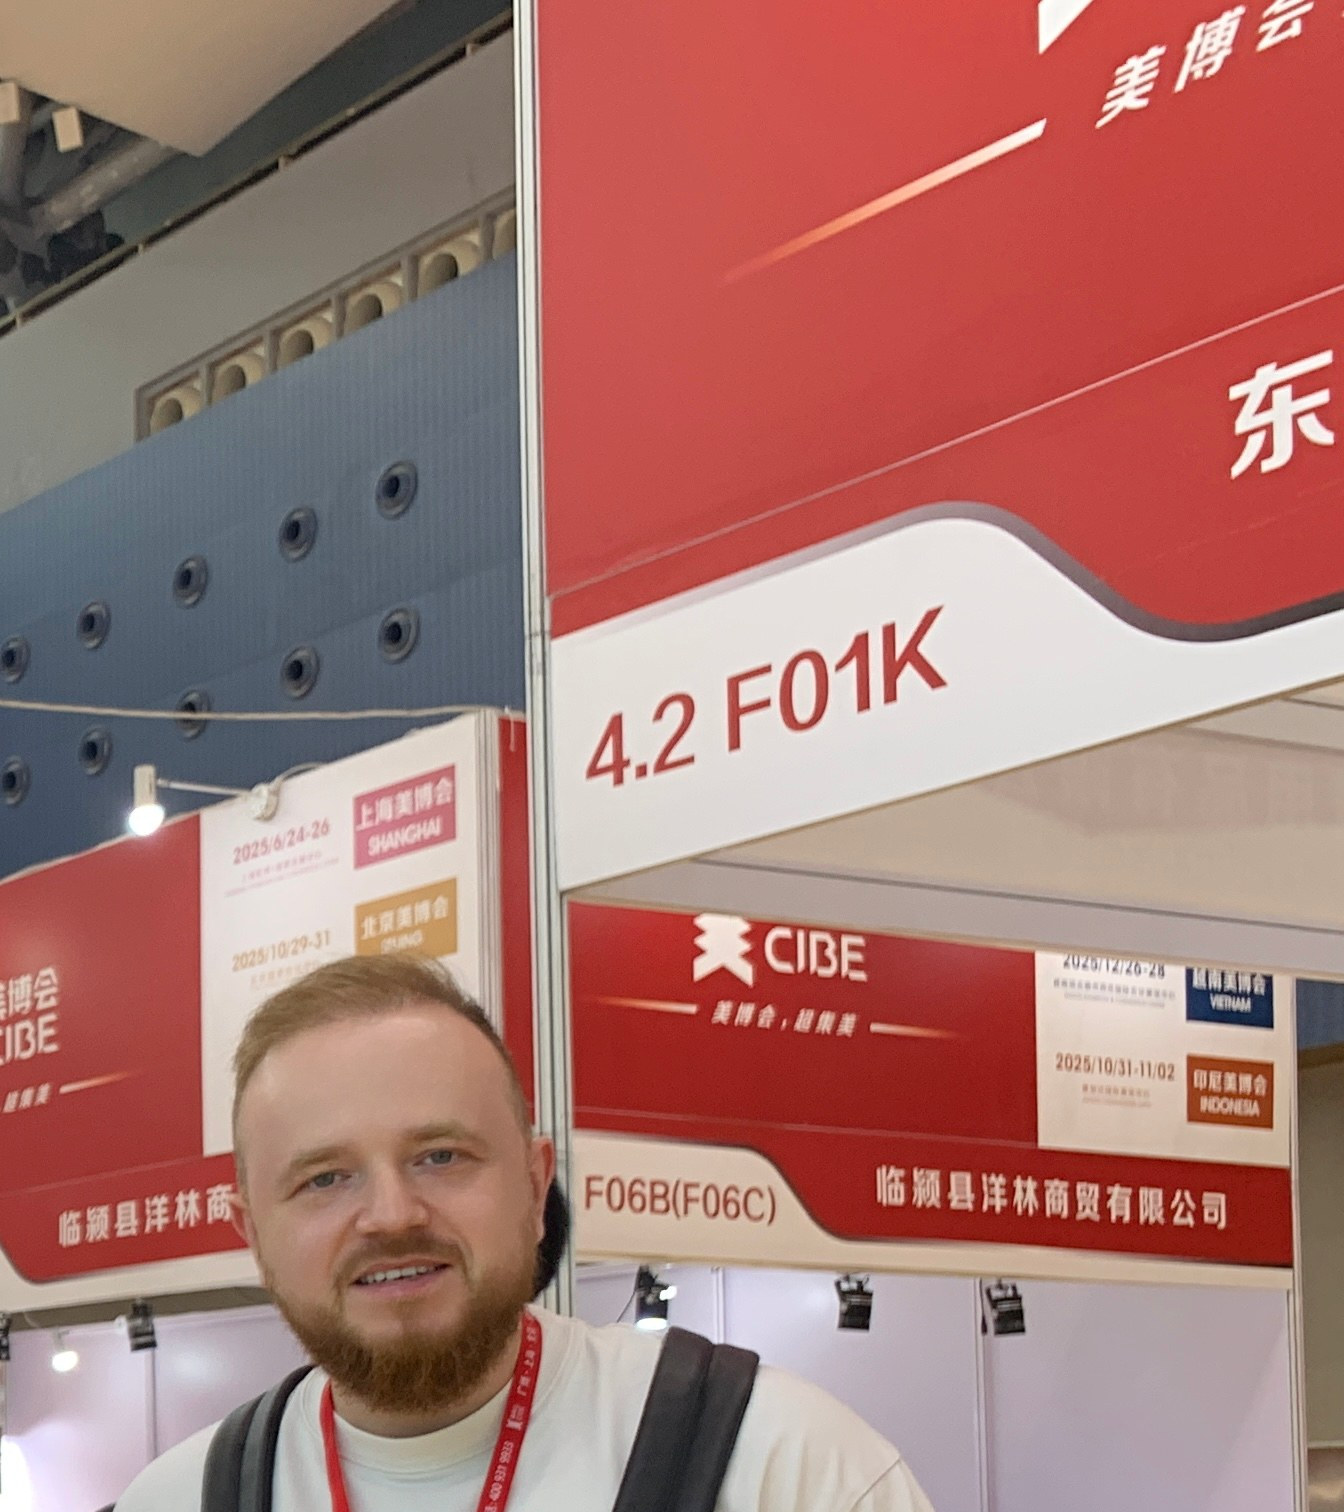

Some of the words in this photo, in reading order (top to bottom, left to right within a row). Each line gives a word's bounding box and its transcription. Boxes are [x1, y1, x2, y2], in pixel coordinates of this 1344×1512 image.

[1229, 350, 1334, 480] 东
[585, 692, 696, 788] 4.2
[726, 603, 948, 754] F01K
[356, 777, 453, 832] 上海美博会
[232, 817, 331, 865] 2025/6/24-26
[368, 817, 442, 856] SHANGHAI
[361, 896, 448, 940] 北京美博会
[231, 928, 331, 973] 2025/10/29-31
[764, 926, 868, 981] CIBE
[1210, 993, 1251, 1013] VIETNAM
[1056, 1053, 1175, 1082] 2025/10/31-11/02
[1193, 1069, 1267, 1096] 印尼美博会
[1200, 1095, 1260, 1117] INDONESIA
[583, 1173, 777, 1227] F06B(F06C)
